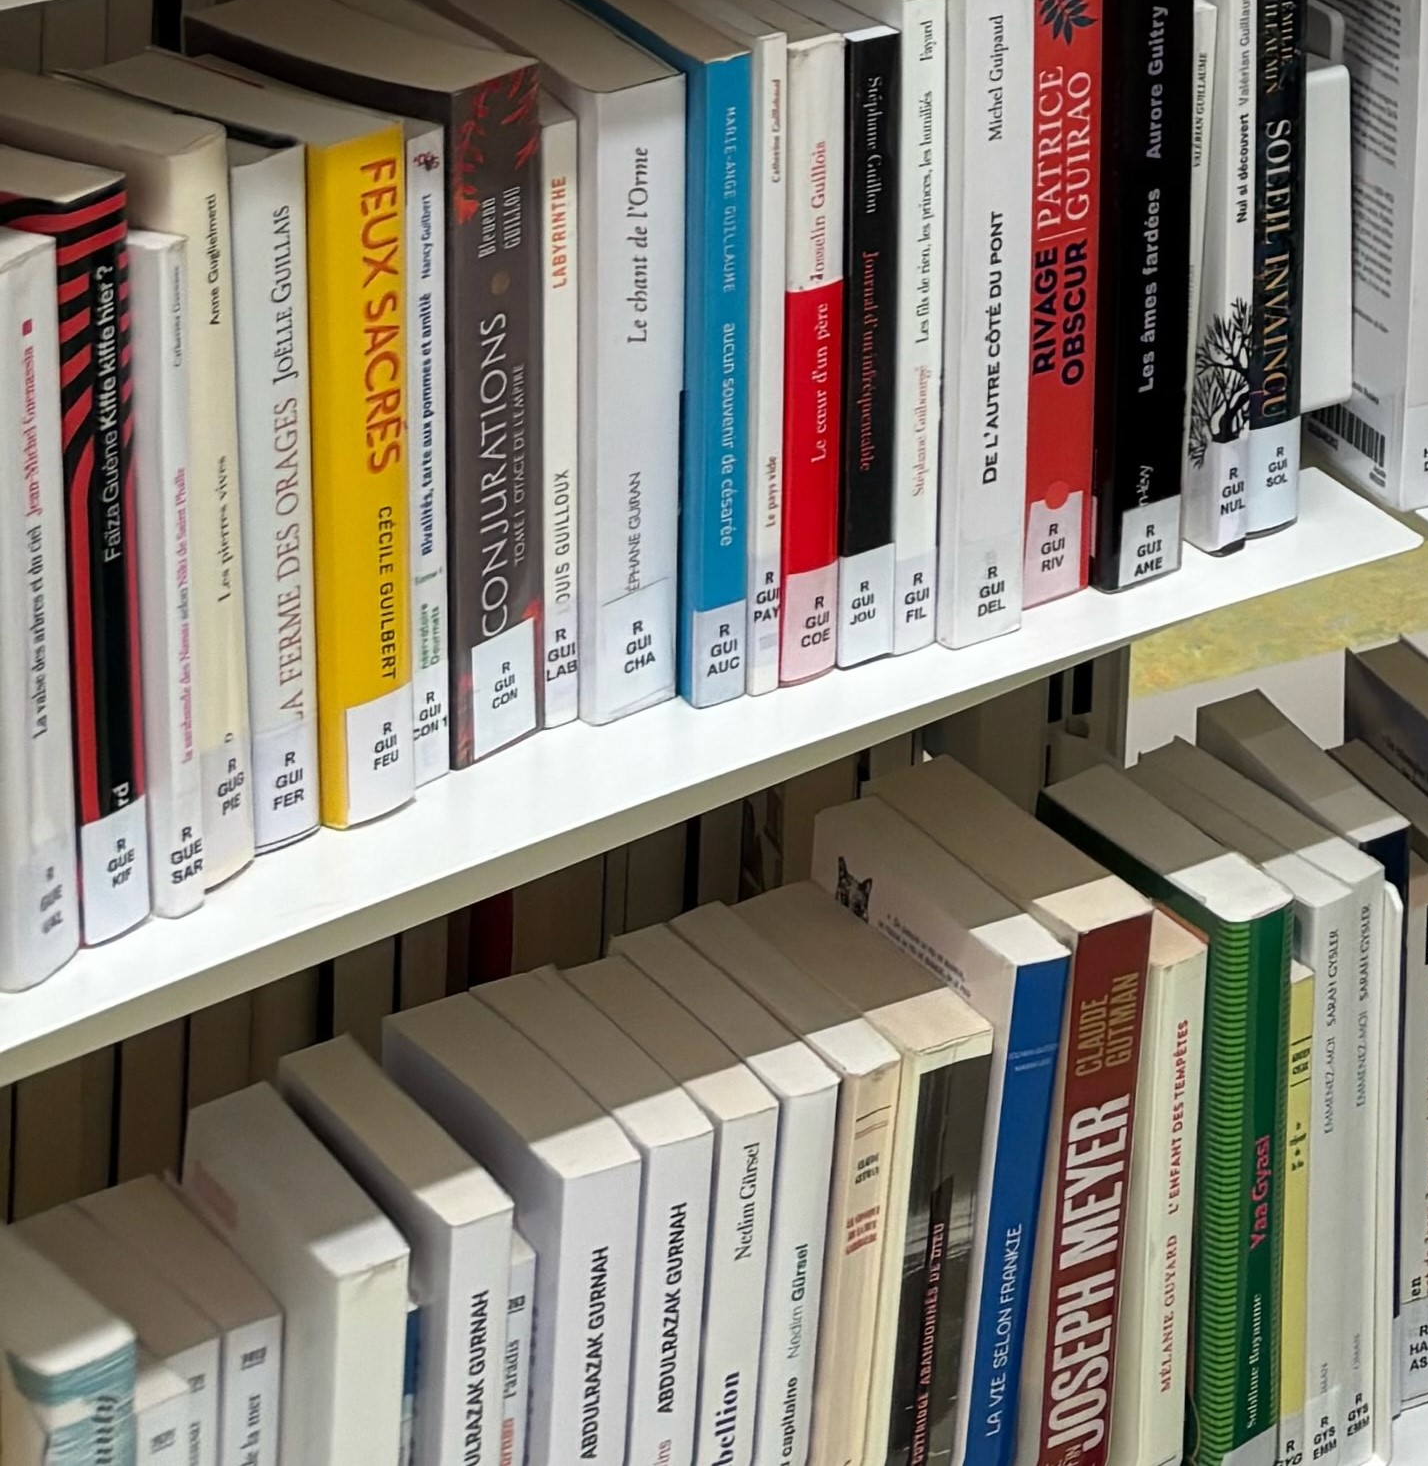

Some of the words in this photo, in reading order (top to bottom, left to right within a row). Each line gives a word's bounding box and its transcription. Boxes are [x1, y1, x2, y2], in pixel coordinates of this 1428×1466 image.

[1147, 5, 1169, 76] Guitry
[1036, 66, 1065, 230] PATRICE
[1065, 72, 1093, 219] GUIRAO
[1145, 84, 1164, 159] Aurore
[627, 147, 648, 219] l'Orme
[1263, 119, 1292, 244] SOLEIL
[269, 206, 293, 303] GUILLAIS
[359, 158, 400, 288] FEUX
[550, 176, 569, 289] LABYRINTHE
[627, 225, 647, 248] de
[989, 211, 1004, 265] PONT
[1141, 189, 1162, 276] fardées
[95, 283, 115, 326] hier
[628, 256, 650, 316] chant
[988, 271, 1002, 297] DU
[1032, 247, 1060, 375] RIVAGE
[1061, 239, 1090, 385] OBSCUR
[1138, 282, 1158, 342] âmes
[96, 328, 116, 373] kiffe
[627, 320, 648, 343] Le
[720, 323, 737, 374] aucun
[982, 302, 1002, 358] CÔTÉ
[1261, 252, 1291, 419] INVAINCU
[97, 377, 118, 430] Kiffe
[362, 293, 408, 474] SACRÉS
[982, 361, 1001, 446] L'AUTRE
[1138, 351, 1156, 393] Les
[720, 378, 737, 449] souvenir
[100, 430, 121, 499] Guène
[274, 398, 299, 516] ORAGES
[479, 313, 509, 637] CONJURATIONS
[720, 454, 737, 475] de
[981, 451, 998, 483] DE
[102, 504, 123, 563] Faïza
[378, 505, 395, 580] CÉCILE
[718, 479, 737, 547] césarée
[275, 523, 301, 582] DES
[276, 589, 303, 686] FERME
[378, 585, 397, 679] GUILBERT
[1075, 993, 1110, 1077] CLAUDE
[1105, 971, 1141, 1068] GUTMAN
[738, 1141, 761, 1199] Gürsel
[1058, 1093, 1132, 1270] MEYER
[1251, 1134, 1273, 1199] Gyasi
[664, 1201, 688, 1286] GURNAH
[732, 1202, 757, 1261] Nedim
[1250, 1203, 1271, 1249] Yaa
[588, 1245, 610, 1329] GURNAH
[999, 1222, 1023, 1305] FRANKIE
[655, 1288, 682, 1414] ABDULRAZAK
[992, 1308, 1014, 1369] SELON
[1046, 1269, 1118, 1453] JOSEPH
[578, 1332, 605, 1460] ABDULRAZAK
[984, 1412, 1003, 1437] LA
[988, 1372, 1008, 1408] VIE
